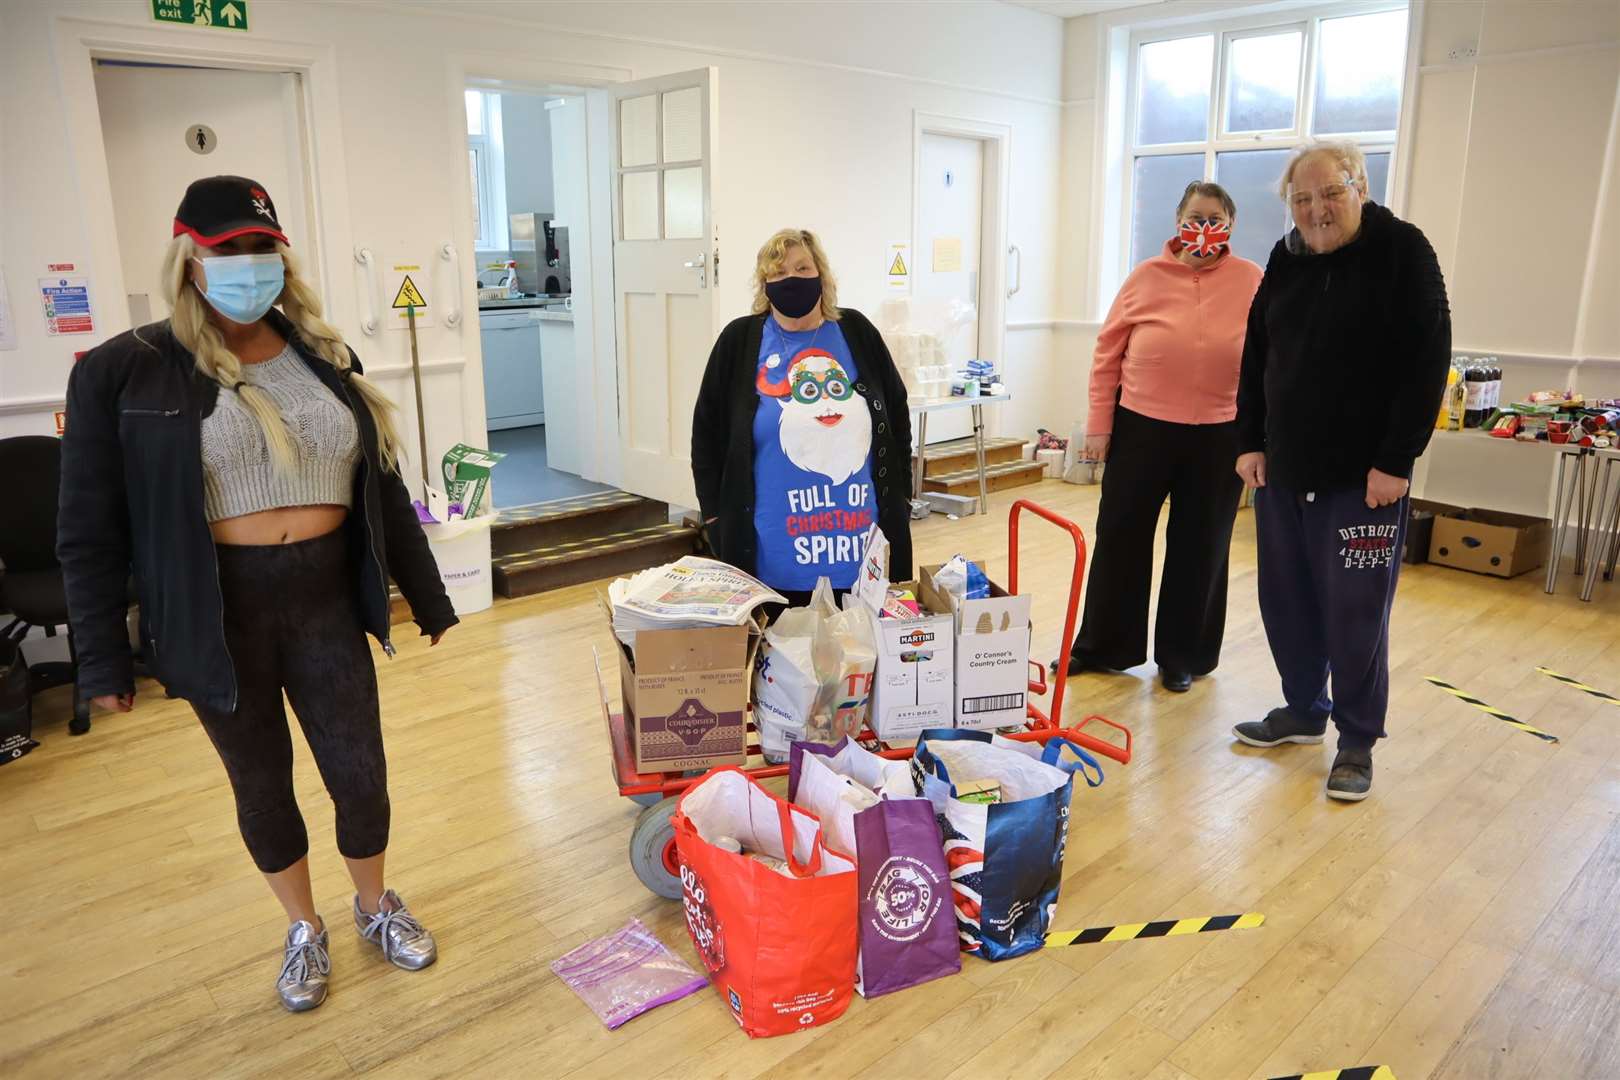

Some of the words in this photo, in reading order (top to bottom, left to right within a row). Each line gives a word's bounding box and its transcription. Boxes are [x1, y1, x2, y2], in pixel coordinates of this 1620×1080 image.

[159, 8, 182, 19] exit
[787, 485, 836, 513] FULL
[848, 483, 868, 507] OF
[1339, 525, 1397, 540] DETROIT
[1349, 538, 1388, 549] STATE
[1344, 557, 1392, 568] D-E-P-T
[901, 633, 934, 643] MARTINI
[983, 651, 1012, 659] Connor's
[674, 760, 711, 768] COGNAC
[880, 869, 901, 894] BAG
[890, 890, 915, 907] 50%
[919, 883, 929, 912] FOR
[881, 910, 909, 927] LIFE
